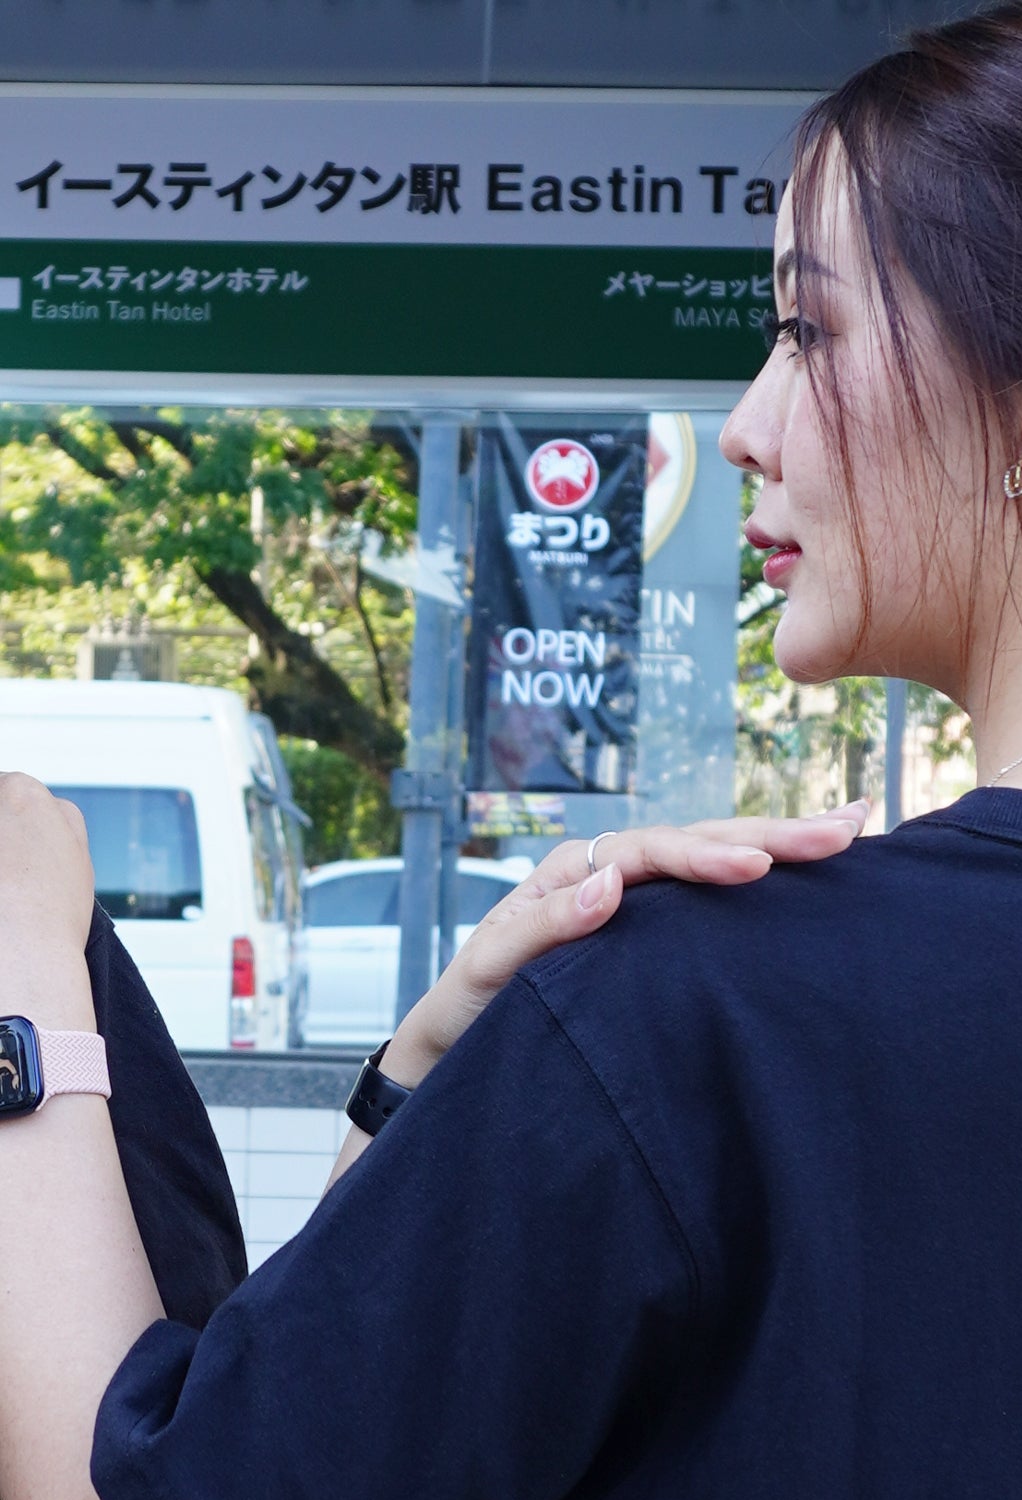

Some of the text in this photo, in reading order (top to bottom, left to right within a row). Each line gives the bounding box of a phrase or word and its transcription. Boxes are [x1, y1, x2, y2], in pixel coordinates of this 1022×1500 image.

[16, 159, 789, 215] イースティンタン駅 Eastin Ta
[31, 264, 309, 294] イースティンタンホテル
[31, 300, 211, 323] Eastin Tan Hotel
[674, 306, 741, 328] MAYA
[506, 512, 611, 551] まつり
[502, 627, 606, 668] OPEN
[502, 669, 605, 709] NOW
